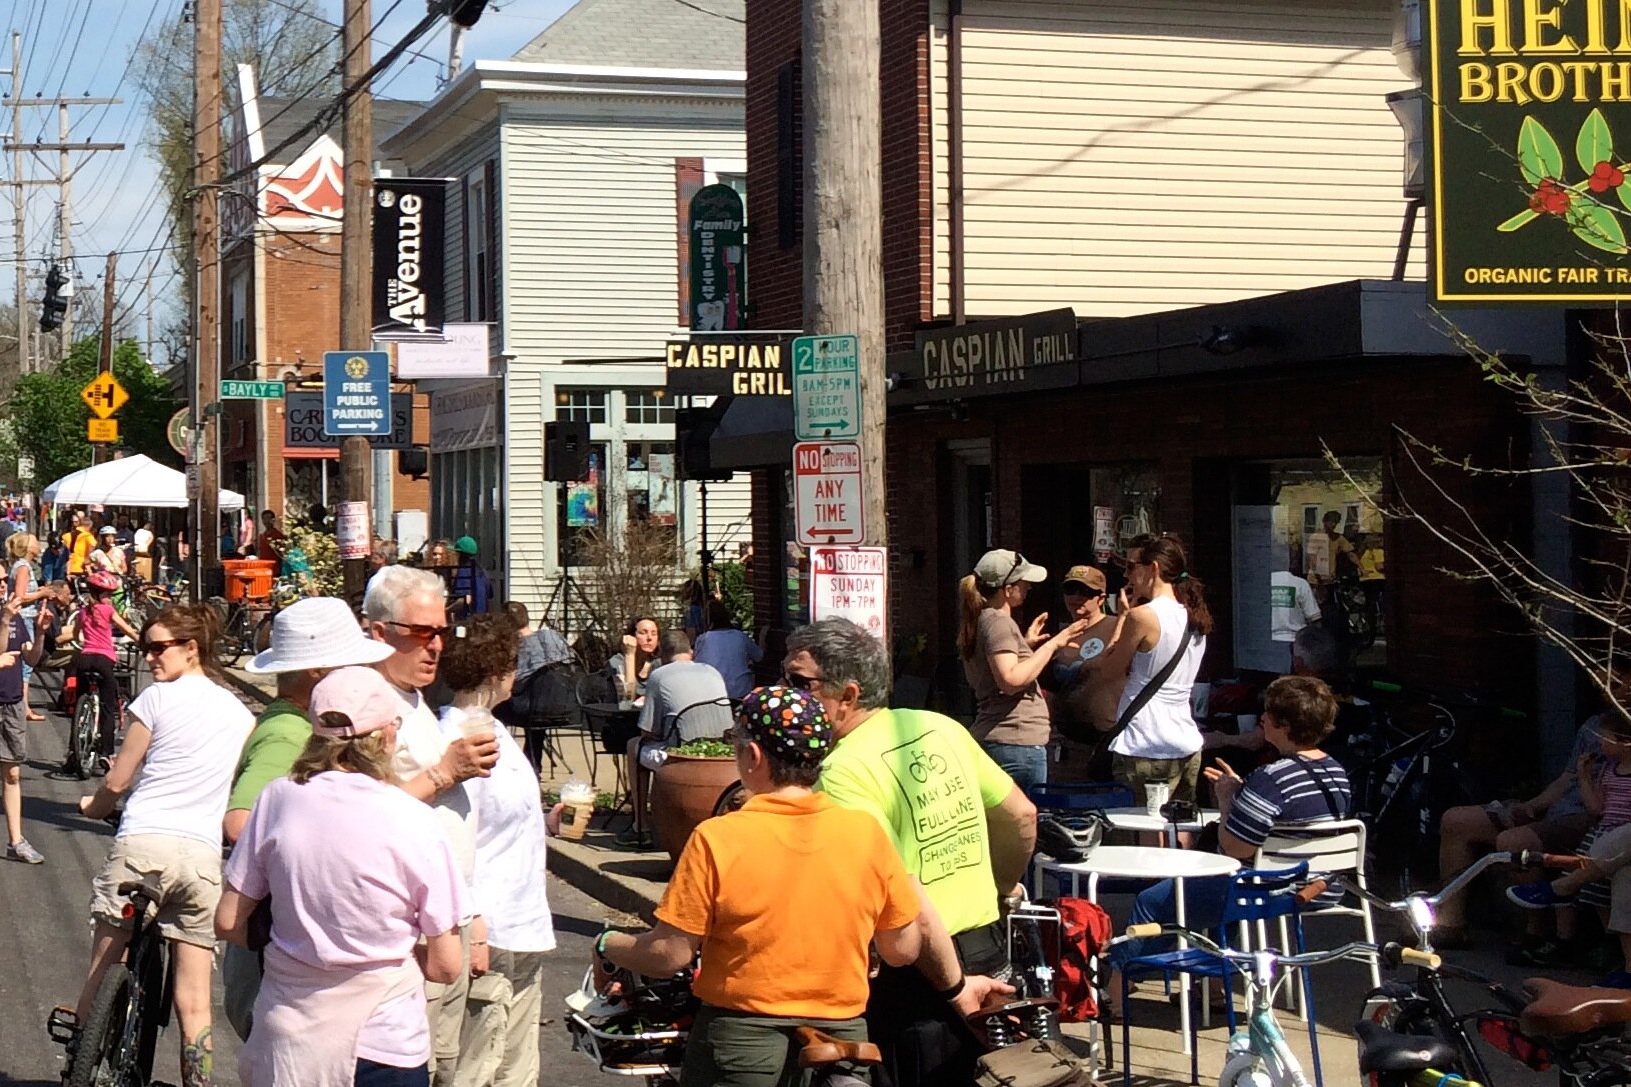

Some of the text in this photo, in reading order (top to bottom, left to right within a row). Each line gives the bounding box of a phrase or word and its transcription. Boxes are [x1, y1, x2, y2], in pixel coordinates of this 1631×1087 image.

[1458, 62, 1631, 106] BROTH
[693, 219, 742, 232] Family
[389, 193, 426, 333] Avenue
[700, 231, 716, 300] DENTISTRY
[1464, 267, 1631, 284] ORGANIC FAIR TR
[387, 278, 398, 307] THE
[666, 344, 780, 369] CASPIAN
[797, 340, 850, 371] 2 HOUR
[815, 355, 855, 369] PARKING
[923, 328, 1074, 390] CASPIAN GRILL
[229, 383, 268, 396] BAYLY
[342, 382, 372, 393] FREE
[732, 372, 792, 395] GRIL
[336, 396, 378, 406] PUBLIC
[809, 395, 845, 406] EXCEPT
[332, 409, 384, 419] PARKING
[807, 407, 849, 418] SUNDAYS
[799, 450, 857, 470] NO STOPPING
[815, 480, 844, 499] ANY
[814, 504, 847, 523] TIME
[818, 554, 834, 571] NO
[830, 578, 875, 592] SUNDAY
[832, 596, 876, 609] 1PM-7PM
[916, 787, 939, 809] MAY
[919, 809, 949, 834] FULL
[957, 832, 981, 845] ANES
[940, 860, 951, 872] TO
